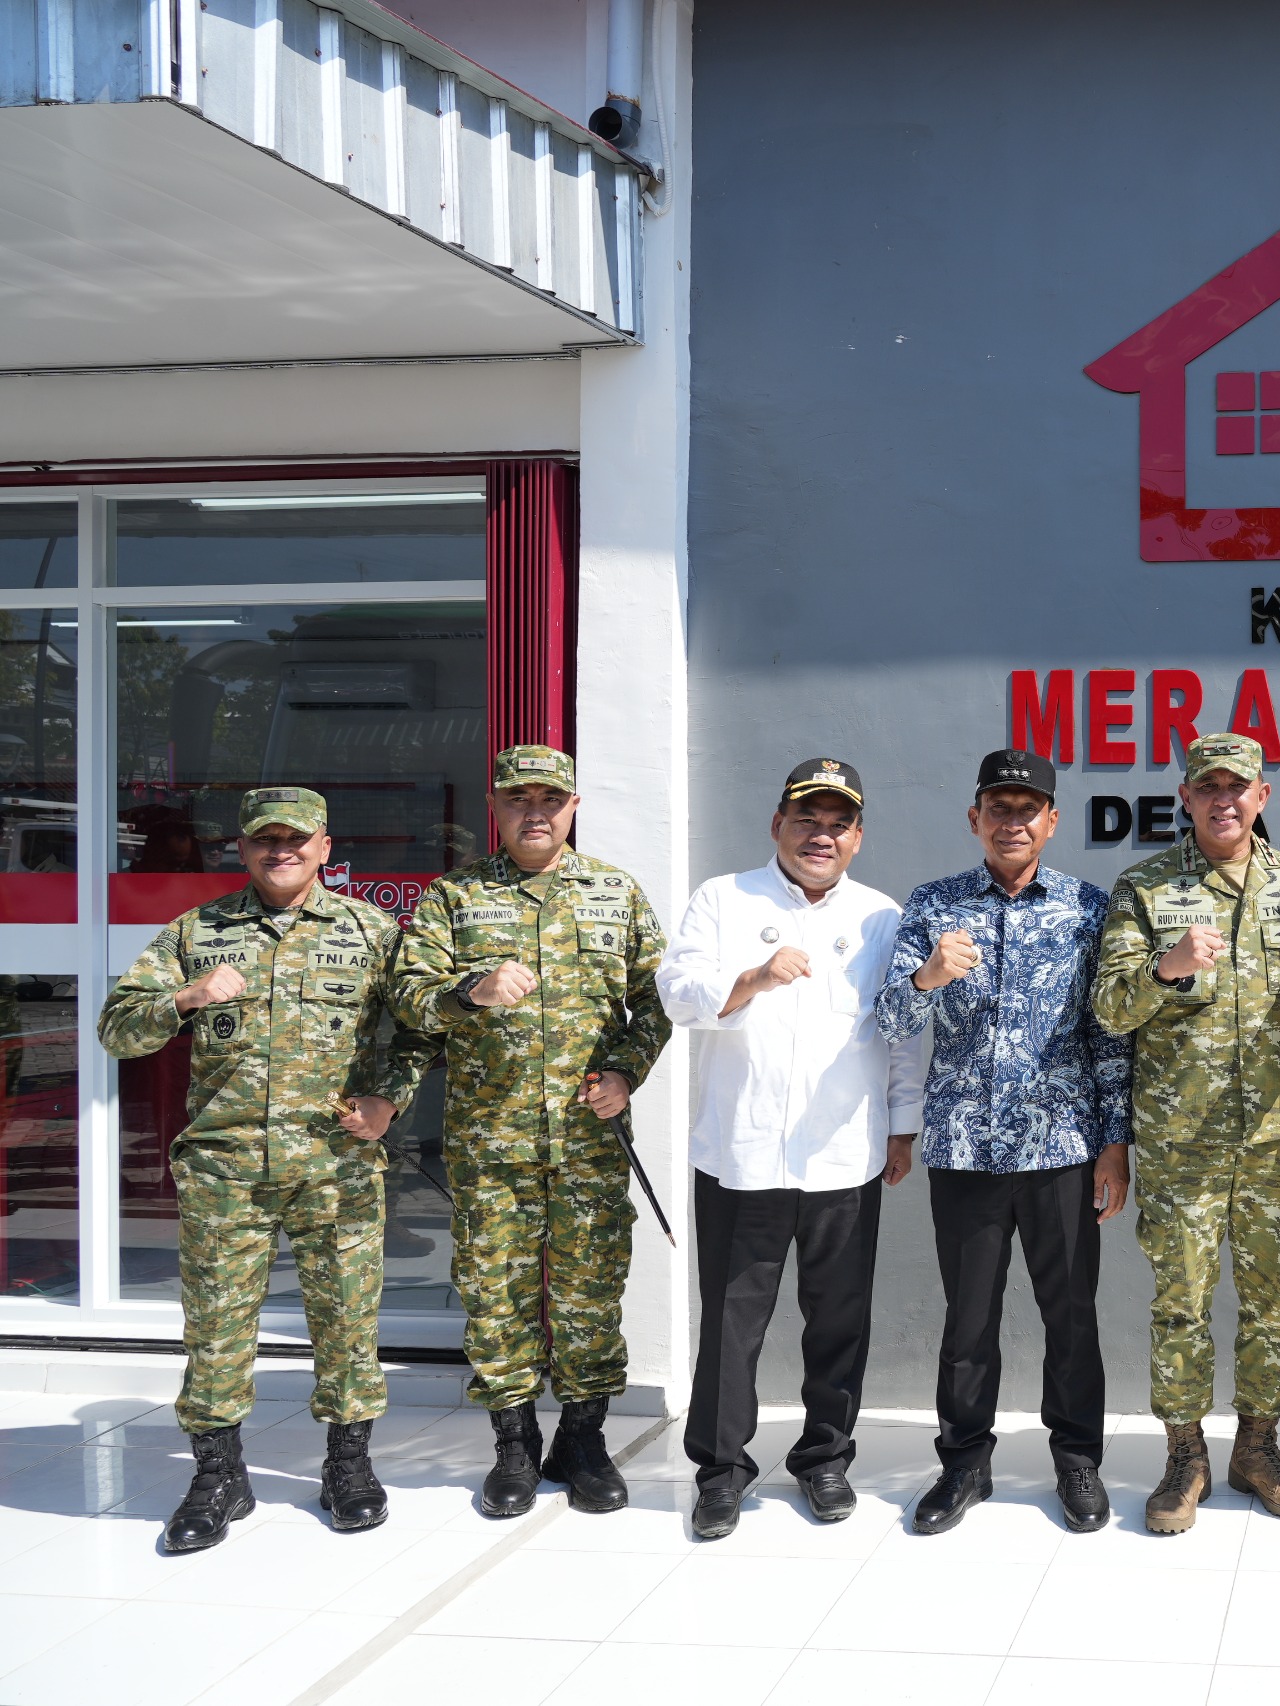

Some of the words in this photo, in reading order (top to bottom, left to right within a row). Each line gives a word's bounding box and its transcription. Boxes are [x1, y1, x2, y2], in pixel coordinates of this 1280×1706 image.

[1091, 795, 1271, 843] DE
[350, 882, 422, 911] KOP
[472, 910, 513, 920] WIJAYANTO
[576, 908, 605, 918] TNI
[611, 909, 629, 920] AD
[1157, 914, 1178, 925] RUDY
[1179, 914, 1212, 926] SALADIN
[194, 952, 247, 970] BATARA
[315, 953, 343, 964] TNI
[349, 955, 369, 968] AD
